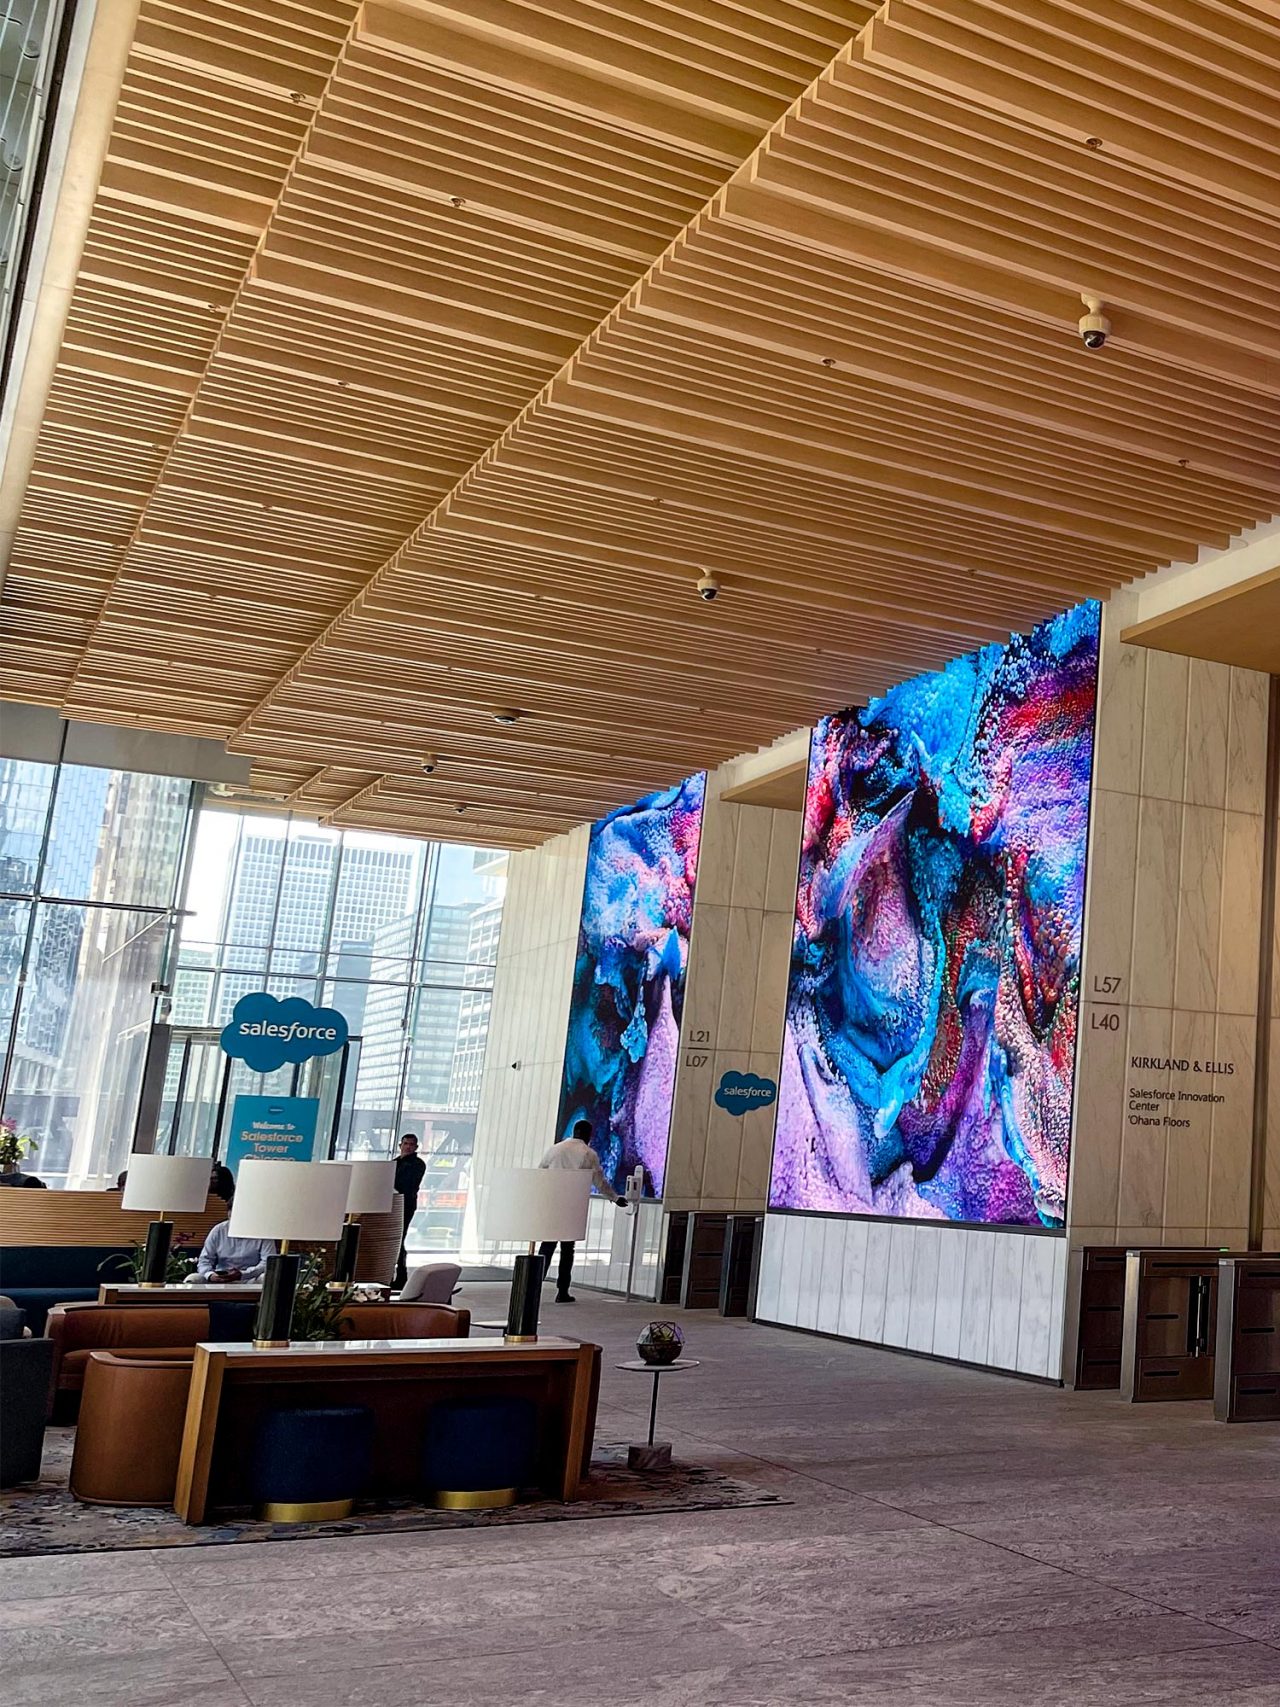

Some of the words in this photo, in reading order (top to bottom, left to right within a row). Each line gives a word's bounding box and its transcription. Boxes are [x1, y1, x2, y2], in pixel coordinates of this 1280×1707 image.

[1094, 976, 1121, 994] L57
[1091, 1013, 1120, 1031] L40
[239, 1020, 336, 1042] salesforce
[689, 1030, 710, 1042] L21
[685, 1055, 708, 1067] L07
[1131, 1056, 1190, 1072] KIRKLAND
[1193, 1061, 1202, 1073] &
[1205, 1062, 1235, 1074] ELLIS
[723, 1086, 772, 1098] salesforce
[1129, 1088, 1176, 1100] Salesforce
[1178, 1091, 1225, 1103] Innovation
[1128, 1100, 1160, 1111] Center
[1163, 1117, 1191, 1128] Floors
[240, 1131, 304, 1142] Salesforce
[254, 1143, 289, 1153] Tower
